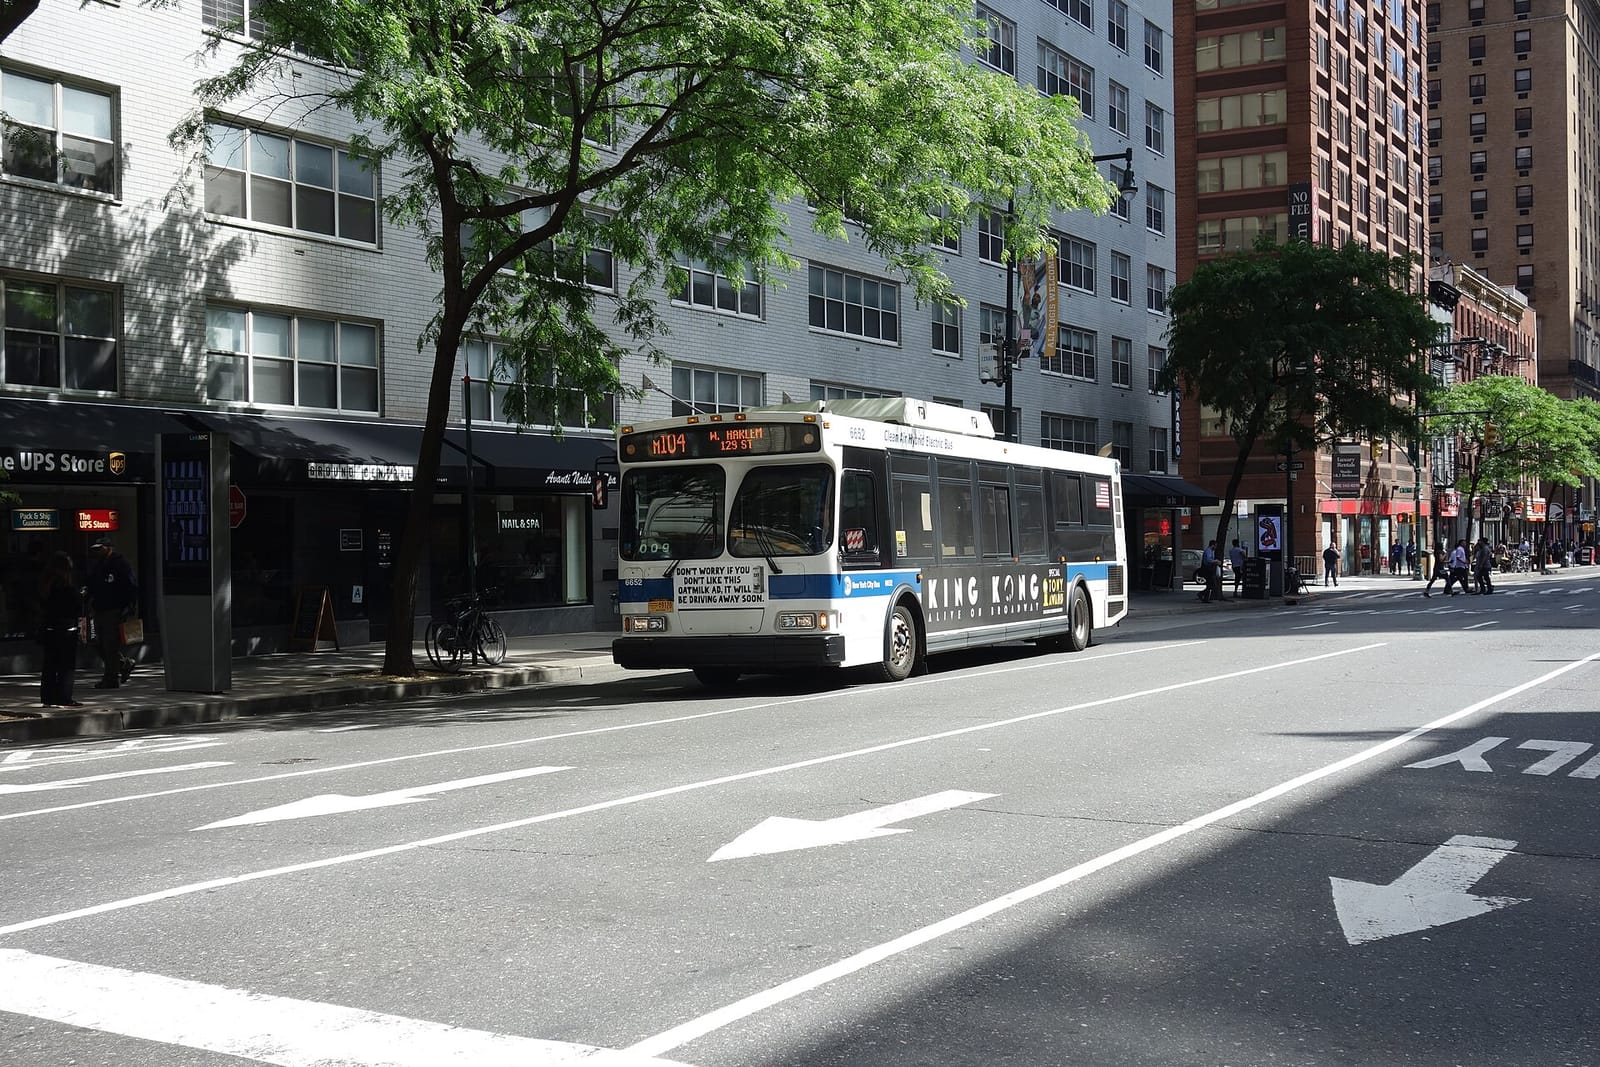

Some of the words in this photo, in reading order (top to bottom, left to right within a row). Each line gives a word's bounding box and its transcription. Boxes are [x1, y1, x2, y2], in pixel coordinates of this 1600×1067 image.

[1293, 191, 1308, 203] NO
[1291, 203, 1310, 216] FEE
[1047, 303, 1056, 326] YOGIS
[1047, 334, 1056, 348] ALL
[709, 431, 720, 441] W.
[849, 427, 866, 440] 6652
[884, 429, 899, 443] Clean
[899, 431, 908, 443] Air
[908, 432, 925, 447] Hybrid
[926, 435, 944, 449] Electric
[944, 438, 953, 450] Bus
[652, 433, 686, 454] M104
[720, 440, 738, 451] 129
[740, 439, 753, 450] ST
[20, 451, 55, 471] UPS
[60, 453, 104, 473] Store
[111, 458, 125, 472] ups
[310, 465, 356, 479] GROUND
[545, 470, 571, 484] Avanti
[571, 471, 592, 485] Nails
[79, 512, 92, 521] The
[79, 520, 93, 529] UPS
[93, 520, 110, 529] Store
[676, 567, 698, 576] DON'T
[699, 566, 725, 575] WORRY
[727, 566, 734, 575] IF
[734, 566, 750, 574] YOU
[624, 578, 643, 586] 6652
[684, 576, 705, 585] DON'T
[706, 576, 722, 584] LIKE
[724, 575, 741, 584] THIS
[678, 586, 710, 595] OATMILK
[724, 585, 731, 594] IT
[733, 585, 751, 593] WILL
[928, 576, 979, 609] KING
[992, 573, 1039, 603] KONG
[678, 596, 687, 604] BE
[689, 595, 717, 604] DRIVING
[719, 595, 740, 603] AWAY
[742, 594, 765, 603] SOON.
[928, 610, 961, 623] ALIVE
[970, 608, 981, 618] ON
[991, 602, 1039, 616] BROADWAY
